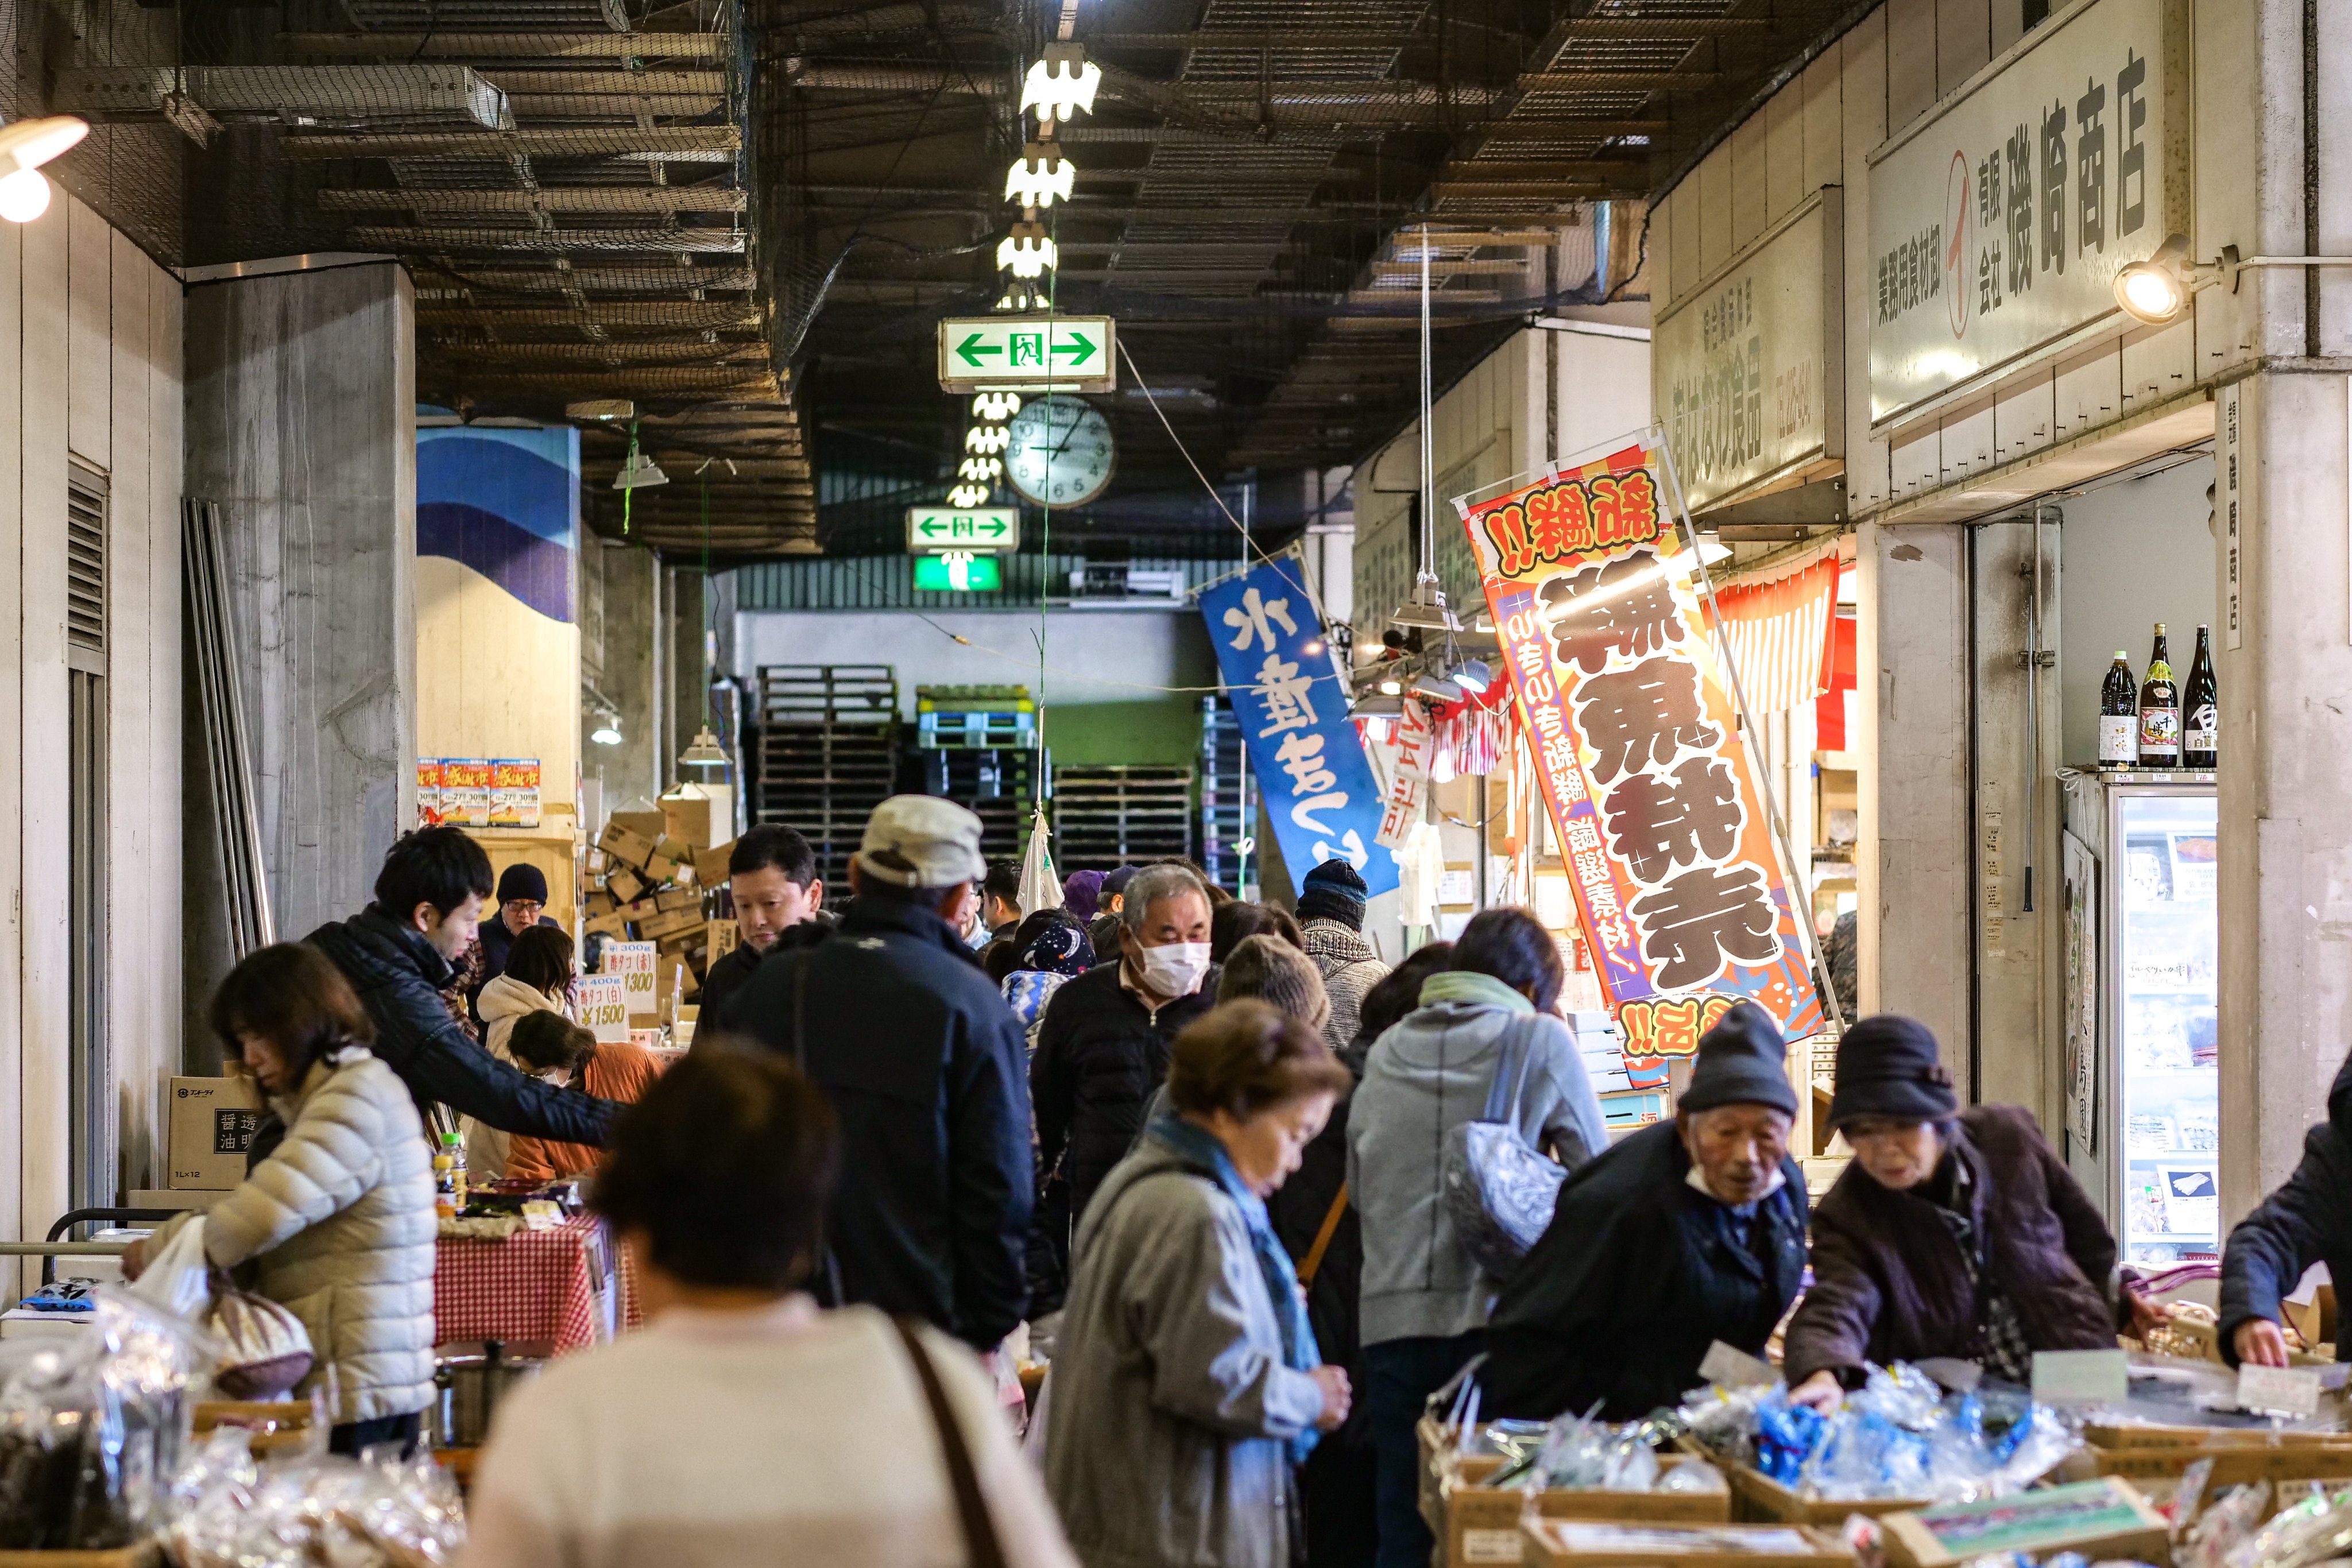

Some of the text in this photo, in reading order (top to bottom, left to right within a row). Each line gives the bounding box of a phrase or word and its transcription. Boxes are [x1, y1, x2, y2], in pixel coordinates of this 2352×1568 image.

[1978, 149, 2001, 229] 有限
[2006, 46, 2146, 298] 磯崎商店
[1878, 224, 1940, 327] 業務用食材卸
[1979, 240, 2002, 316] 会社
